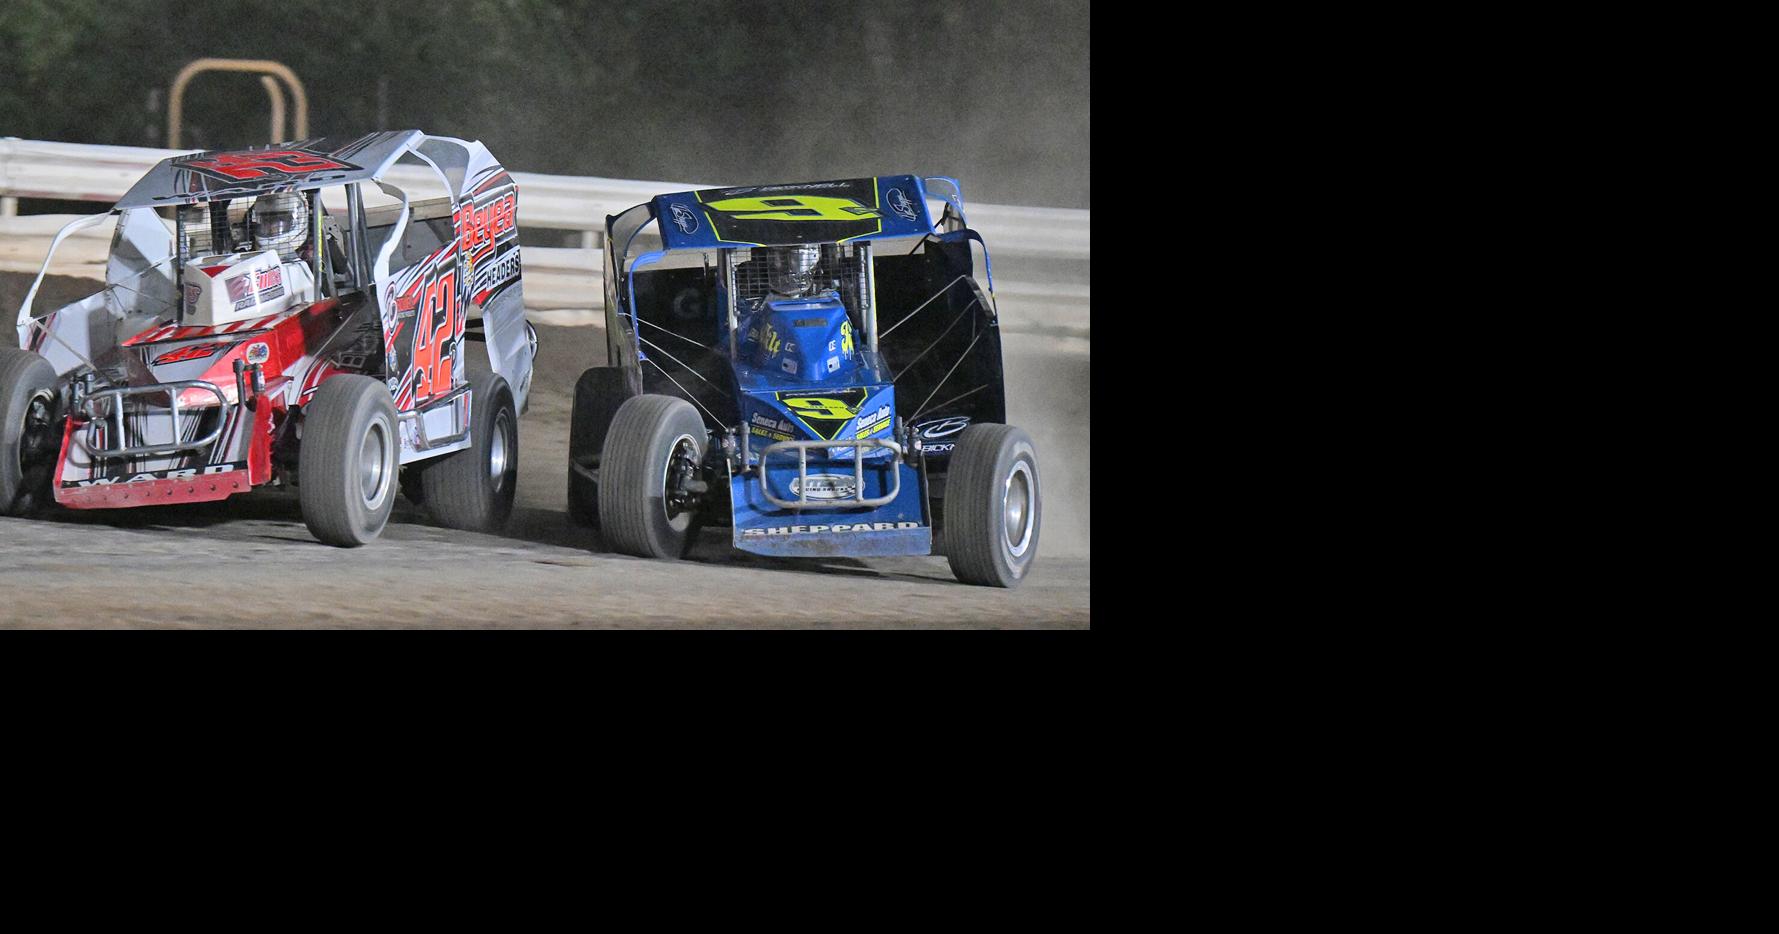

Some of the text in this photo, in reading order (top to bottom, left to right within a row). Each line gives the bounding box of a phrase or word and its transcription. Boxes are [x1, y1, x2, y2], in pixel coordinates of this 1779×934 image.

[461, 194, 516, 258] Beyea
[486, 256, 521, 288] HEADERS
[751, 412, 778, 429] Seneca
[857, 412, 877, 431] Seneca
[78, 464, 234, 487] WARD
[743, 521, 919, 536] SHEPPARD
